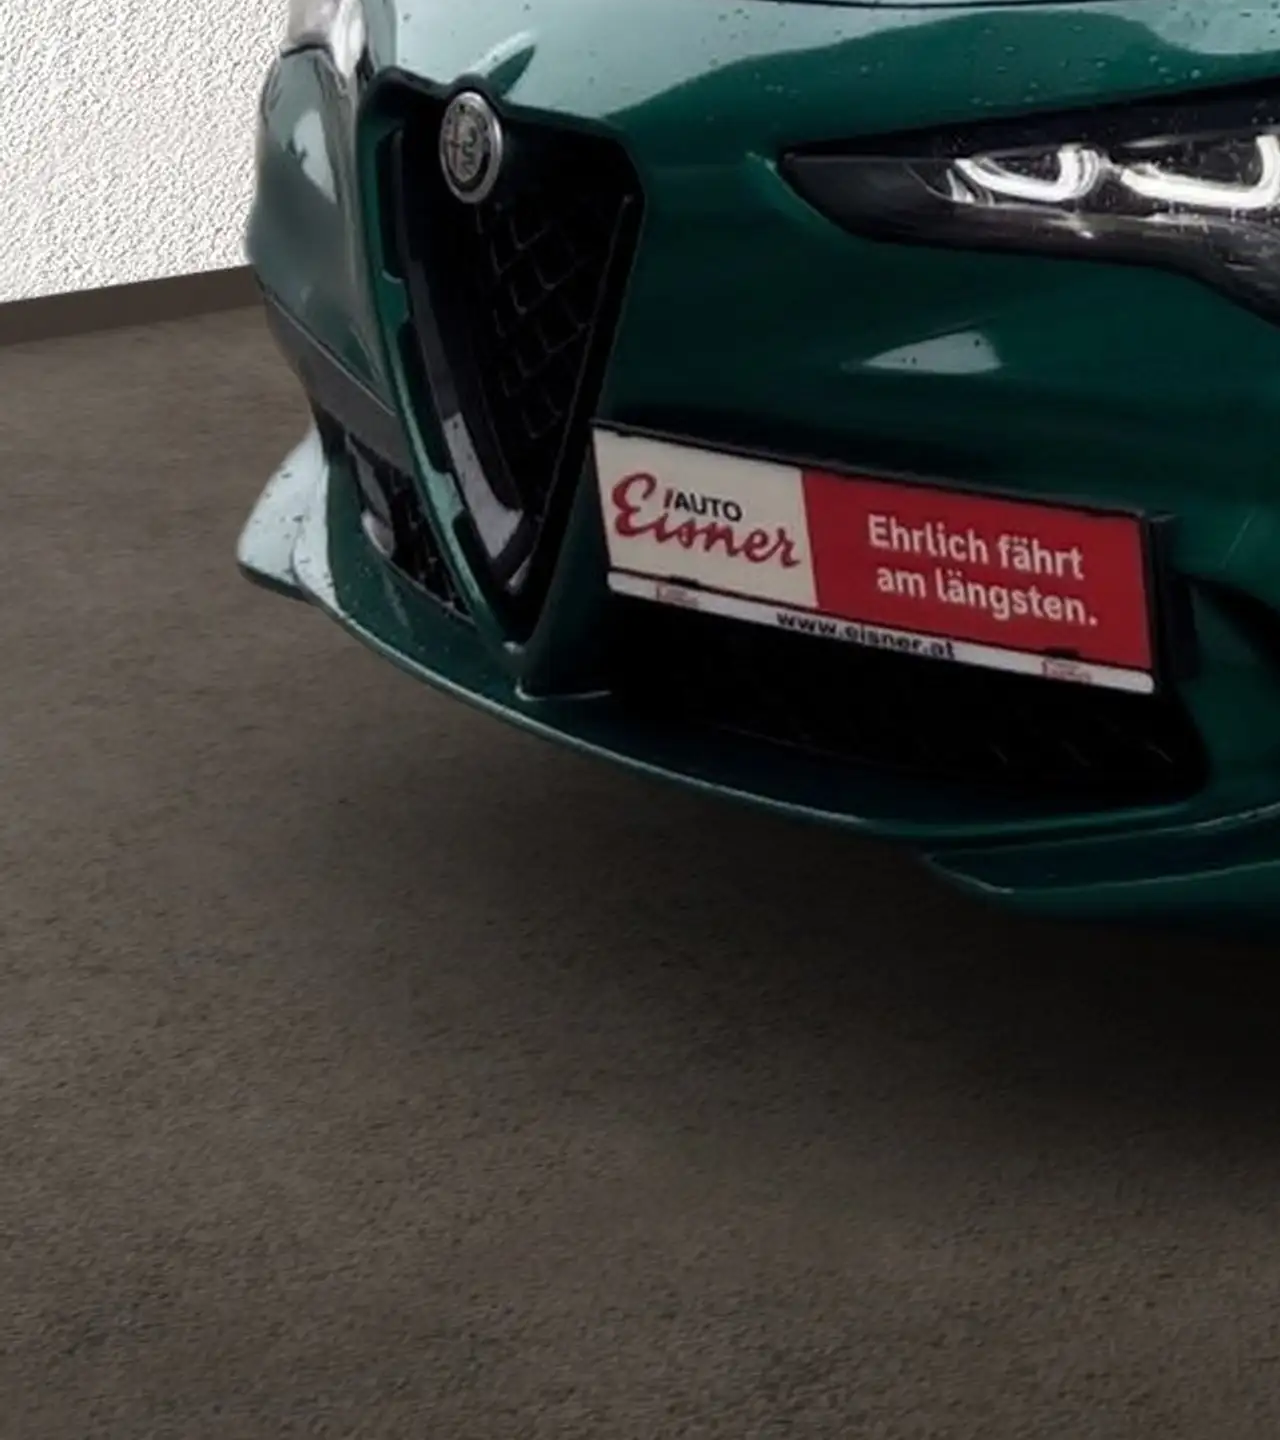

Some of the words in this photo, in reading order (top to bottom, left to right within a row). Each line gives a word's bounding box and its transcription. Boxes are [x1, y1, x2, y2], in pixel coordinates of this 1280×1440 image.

[611, 472, 801, 569] Eisner
[674, 490, 743, 523] AUTO
[867, 513, 990, 565] Ehrlich
[998, 532, 1086, 581] fährt
[876, 566, 926, 599] am
[935, 566, 1099, 628] längsten.
[776, 610, 956, 661] www.eisner.at
